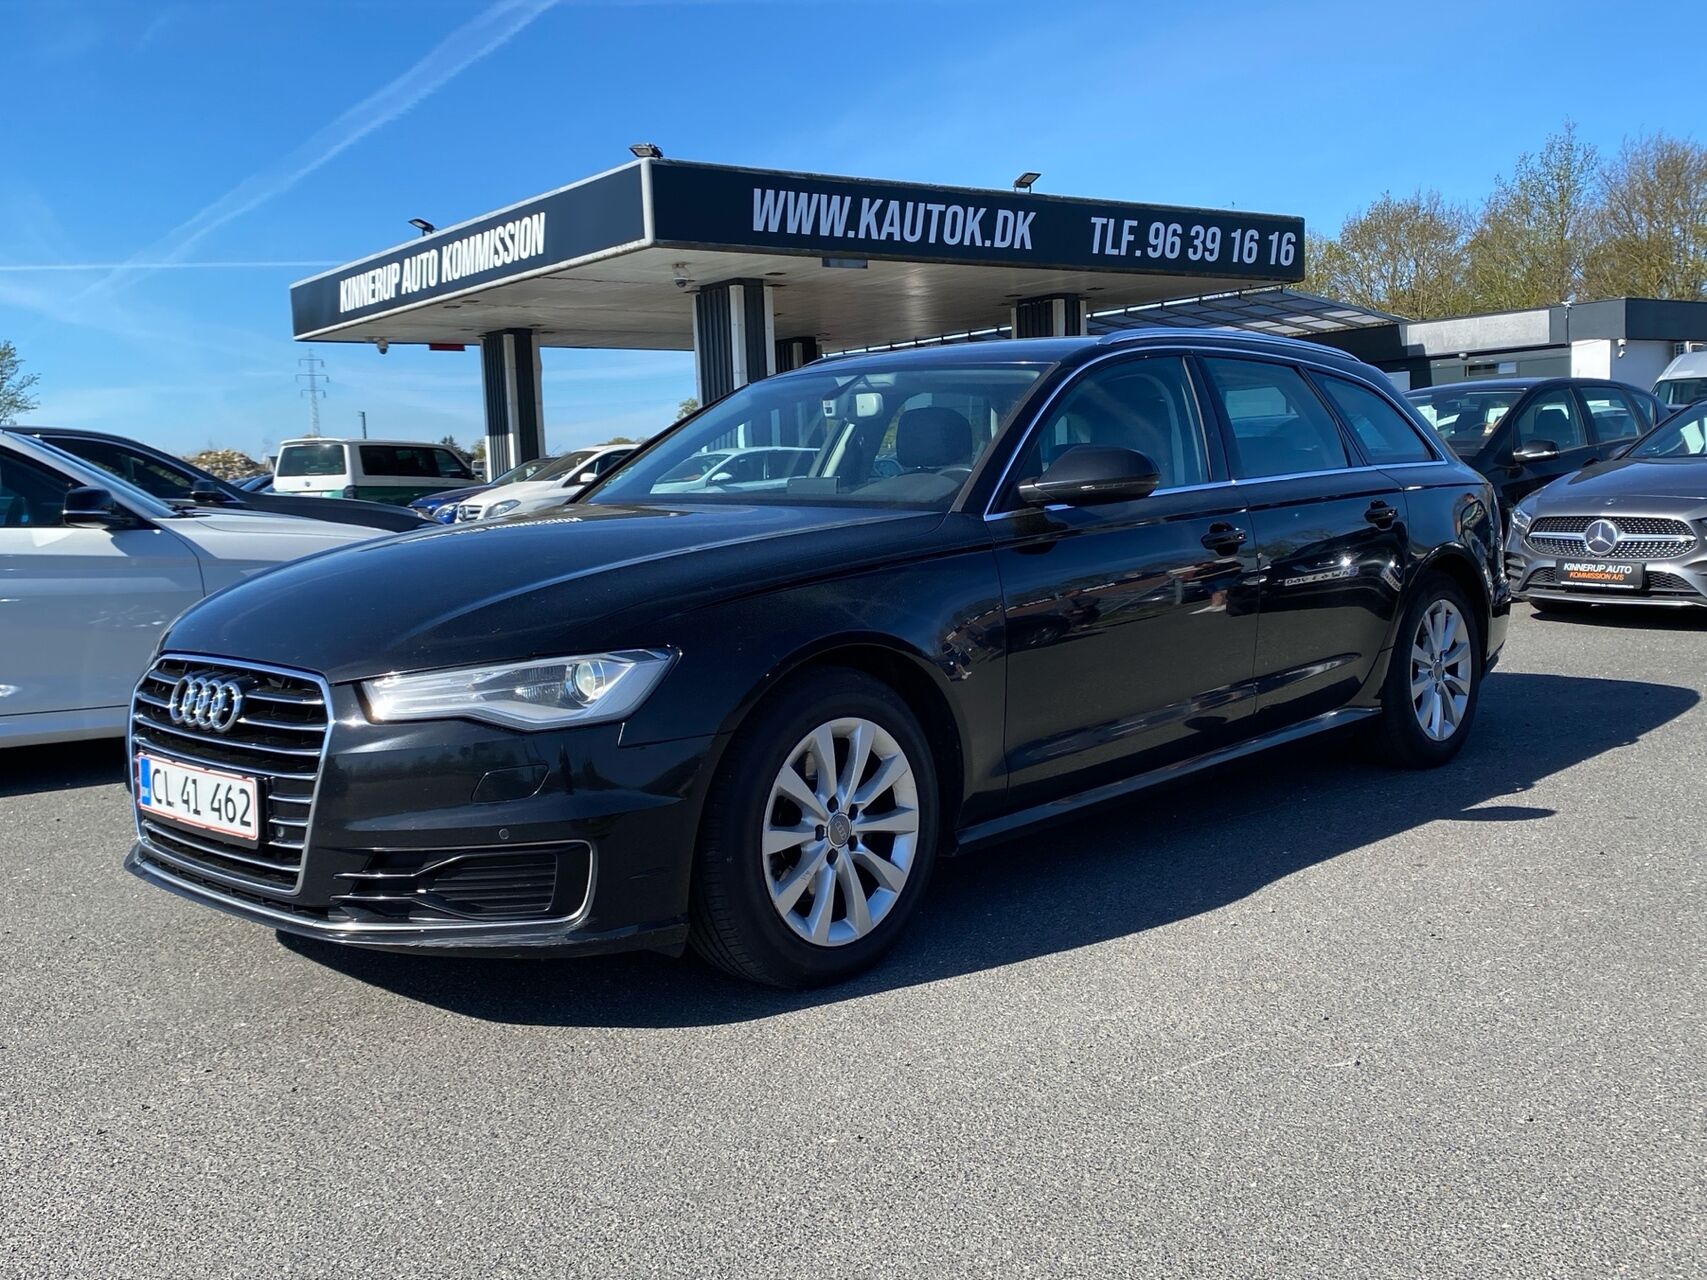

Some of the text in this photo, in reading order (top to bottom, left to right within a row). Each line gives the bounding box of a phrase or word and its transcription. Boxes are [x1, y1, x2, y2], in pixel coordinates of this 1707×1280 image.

[752, 188, 1036, 250] WWW.KAUTOK.DK
[1090, 216, 1296, 266] TLF. 96 39 16 16
[339, 212, 546, 313] KINNERUP AUTO KOMMISSION
[1563, 563, 1632, 574] KINNERUP AUTO
[1569, 572, 1625, 581] KOMMISSION A/S
[152, 768, 252, 828] CL 41 462
